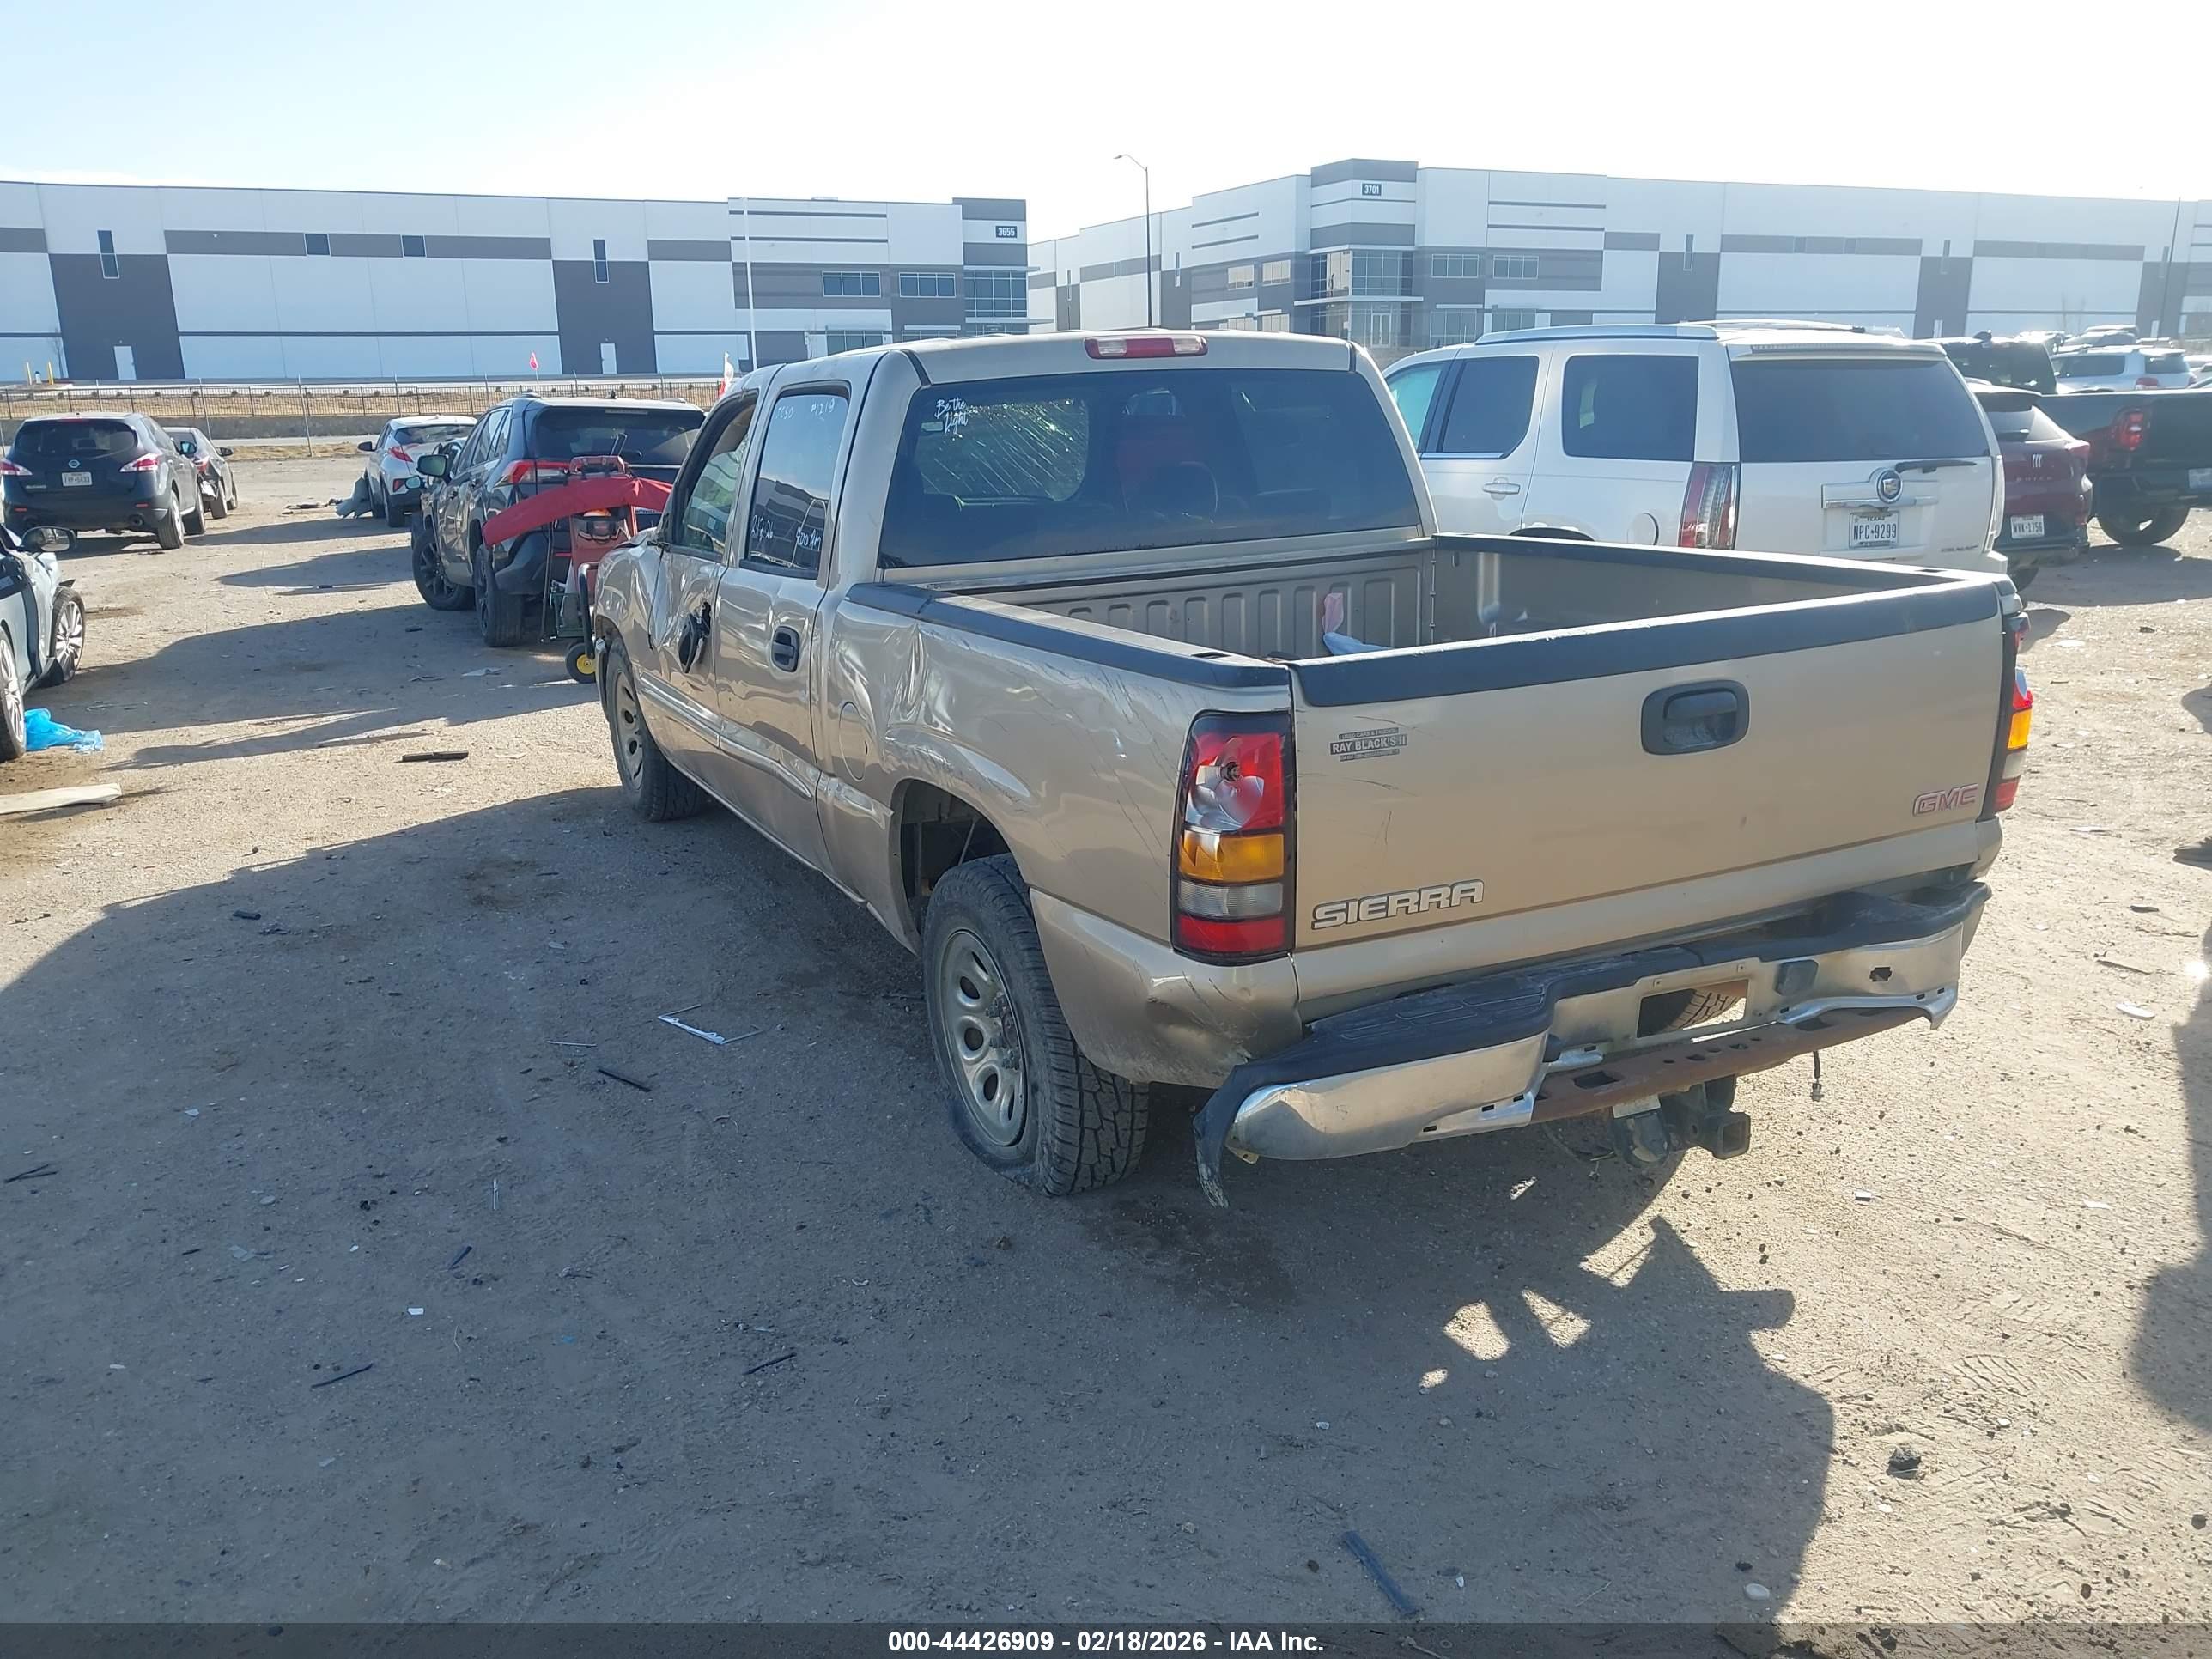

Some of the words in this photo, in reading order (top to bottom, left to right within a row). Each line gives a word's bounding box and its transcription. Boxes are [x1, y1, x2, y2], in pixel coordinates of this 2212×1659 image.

[1364, 185, 1380, 195] 3701
[998, 227, 1016, 236] 3655
[934, 399, 951, 419] Be
[949, 396, 967, 411] the
[945, 411, 969, 436] Light
[1332, 741, 1352, 754] RAY
[1355, 736, 1396, 751] BLACK'S
[1400, 735, 1407, 745] II
[1912, 783, 1979, 817] GMC
[1311, 878, 1485, 930] SIERRA
